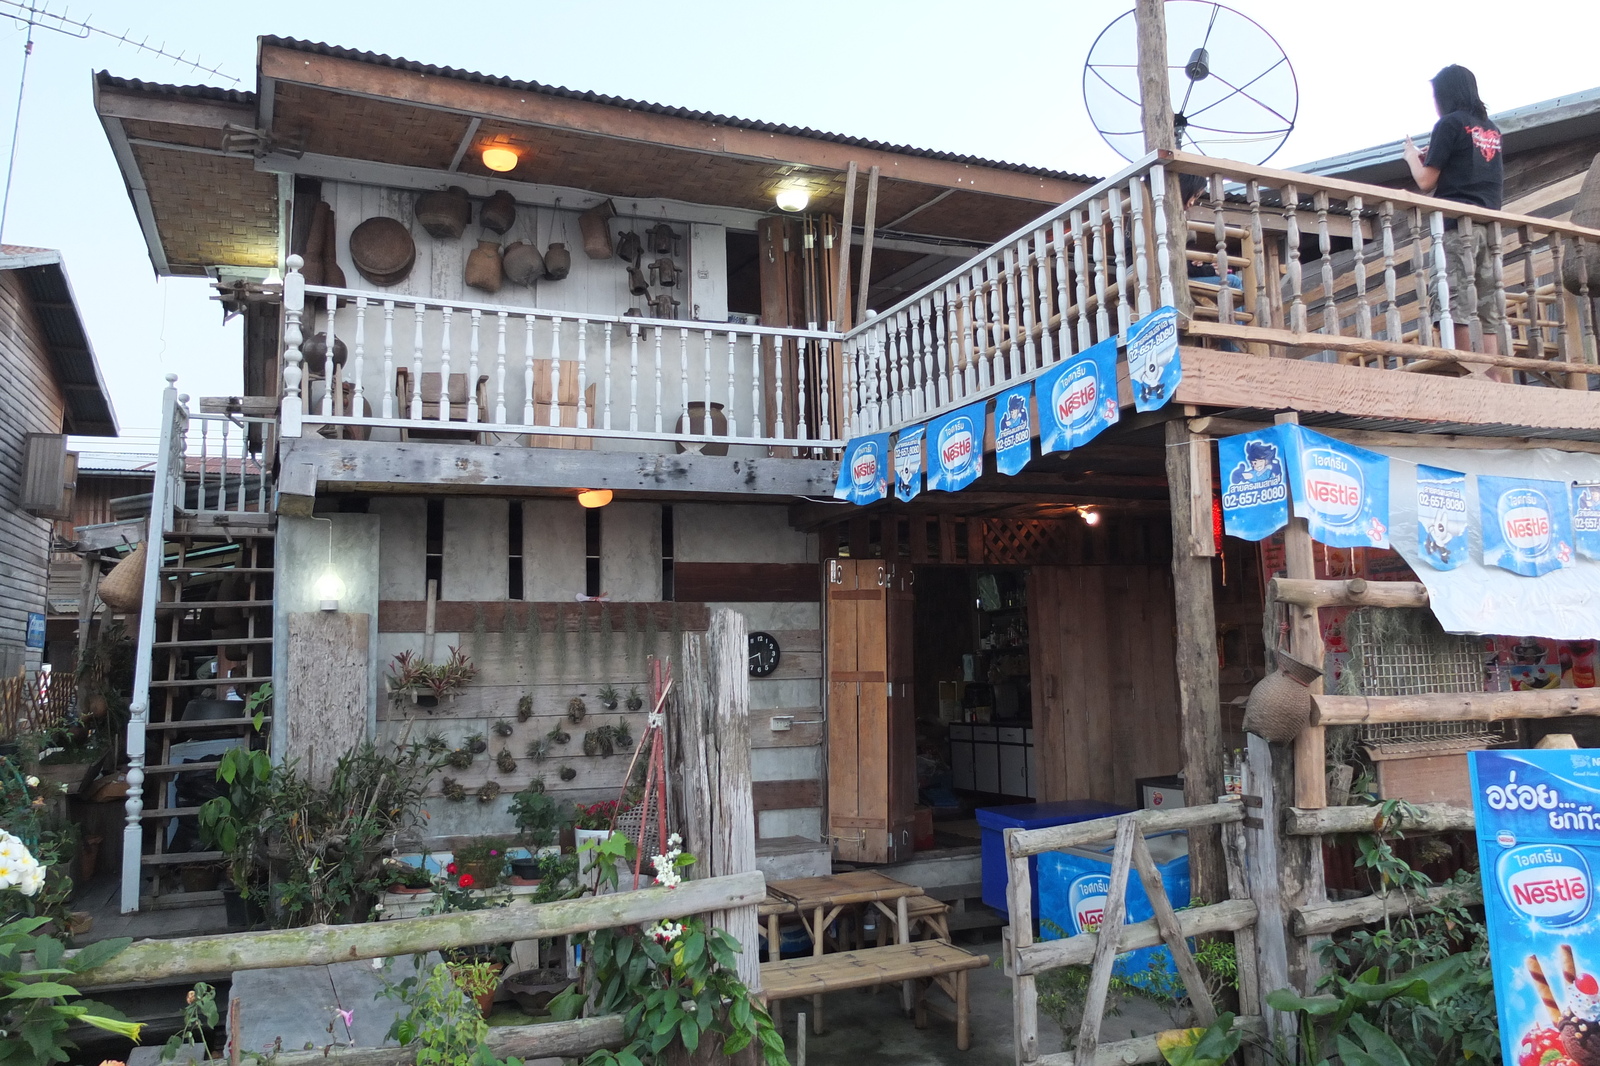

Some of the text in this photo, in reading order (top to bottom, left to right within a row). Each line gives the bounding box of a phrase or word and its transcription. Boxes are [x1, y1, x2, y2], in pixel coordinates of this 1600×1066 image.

[1129, 324, 1174, 362] 02-657-8080
[1059, 382, 1095, 420] Nestlé
[943, 437, 971, 464] Nestlé
[996, 429, 1029, 451] 02-657-8080
[1312, 454, 1347, 471] ไอศกรีม
[1224, 485, 1284, 507] 02-657-8080
[1307, 479, 1358, 506] Nestlé
[1419, 493, 1465, 511] 02-657-8080
[1506, 517, 1548, 538] Nestlé
[1513, 849, 1562, 867] ไอศกรีม
[1512, 876, 1586, 906] Nestlé
